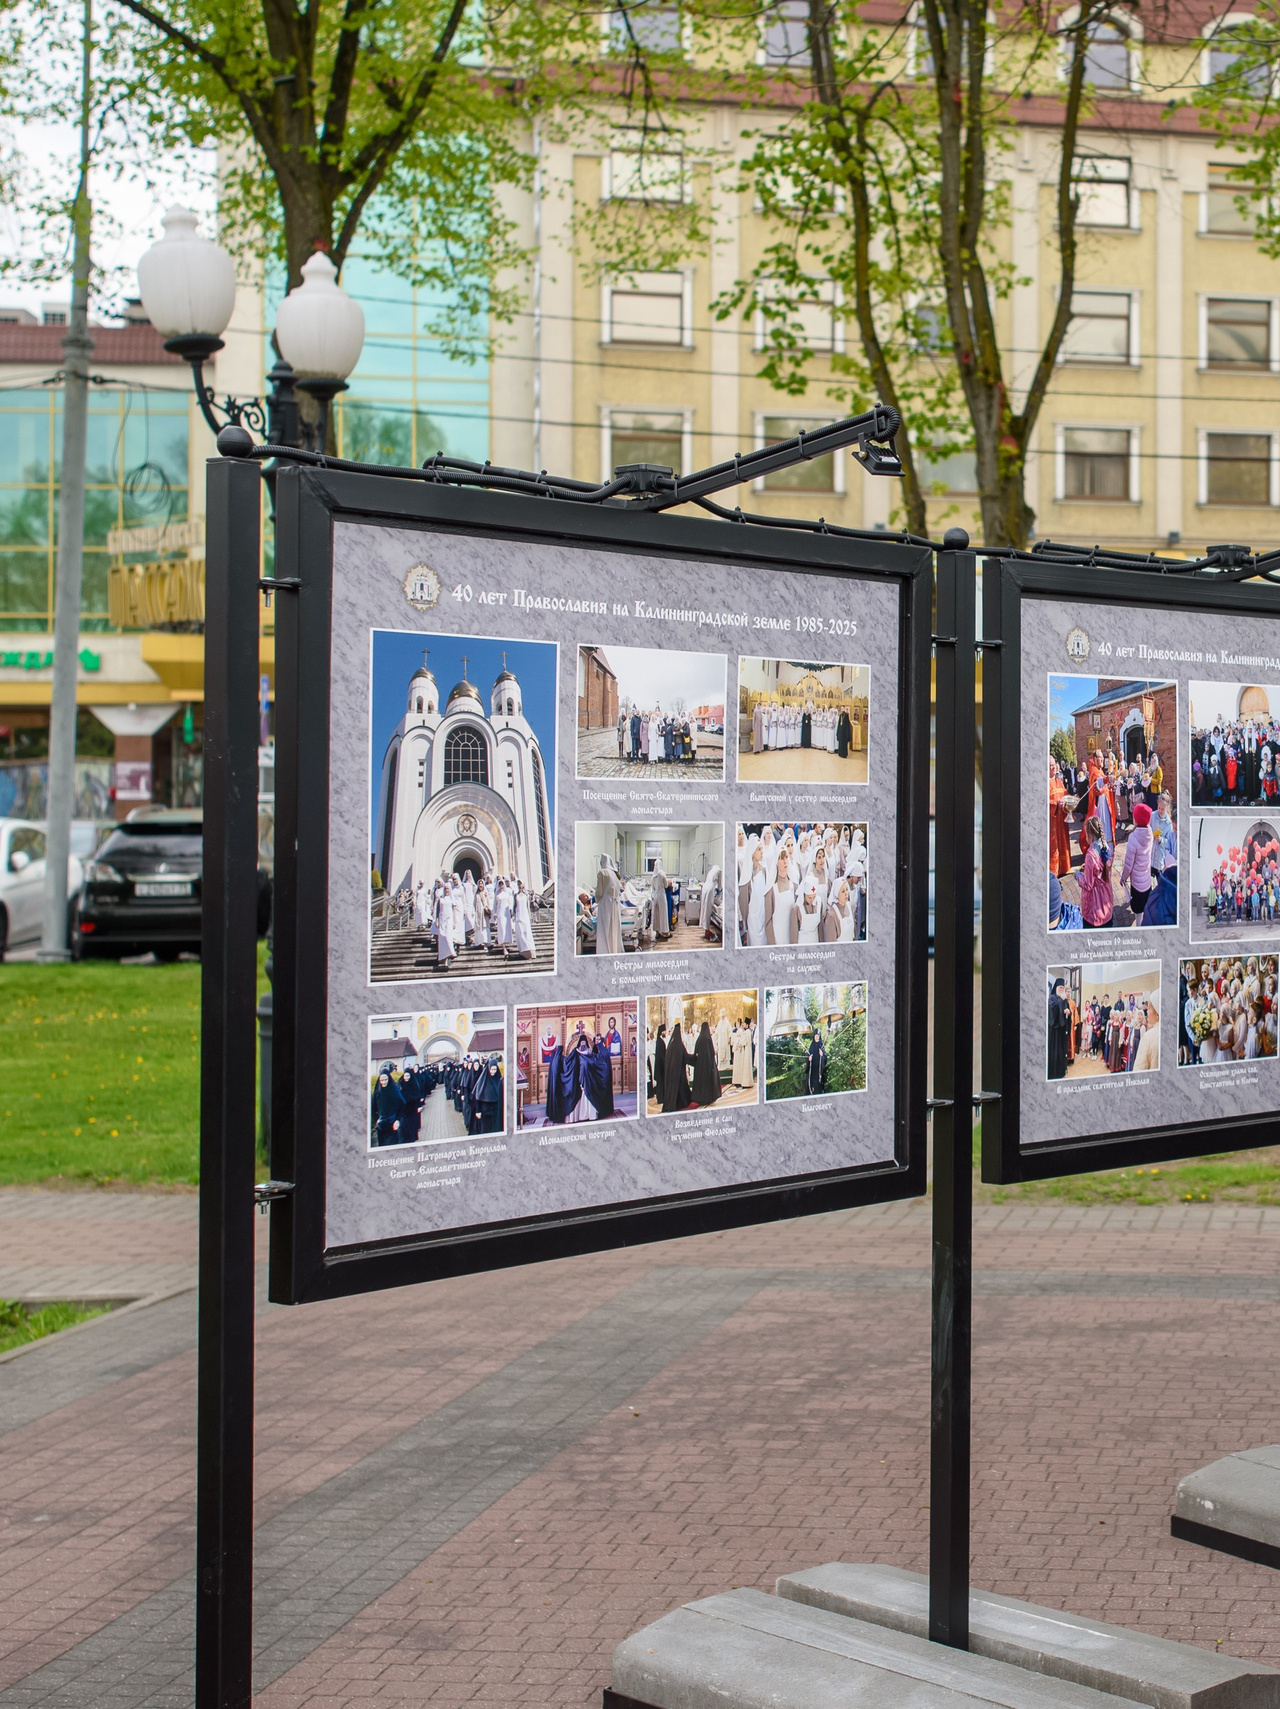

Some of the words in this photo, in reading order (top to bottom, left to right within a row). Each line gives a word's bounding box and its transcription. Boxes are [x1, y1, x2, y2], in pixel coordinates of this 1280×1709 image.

[451, 583, 473, 603] 40
[478, 591, 507, 606] лет
[513, 588, 607, 614] Православия
[612, 602, 629, 617] на
[634, 600, 748, 628] Калининградской
[752, 616, 791, 631] земле
[795, 615, 857, 637] 1985-2025
[1097, 641, 1112, 656] 40
[1115, 646, 1135, 658] лет
[1138, 644, 1202, 663] Православия
[1205, 653, 1218, 663] на
[582, 789, 627, 802] Посещение
[629, 790, 719, 803] Свято-Екатерининского
[631, 806, 673, 816] монастыря
[1114, 937, 1121, 946] 19
[769, 951, 796, 963] Сестры
[797, 951, 836, 961] милосердия
[613, 960, 643, 972] Сестры
[645, 959, 689, 970] милосердия
[797, 964, 822, 975] службе
[611, 977, 617, 985] в
[619, 973, 662, 984] больничной
[664, 972, 691, 981] палате
[801, 1102, 833, 1113] Благовест
[675, 1117, 714, 1130] Возведение
[721, 1115, 733, 1123] сан
[539, 1132, 587, 1146] Монашеский
[588, 1129, 617, 1140] постриг
[367, 1155, 415, 1169] Посещение
[417, 1148, 467, 1162] Патриархом
[469, 1144, 507, 1157] Кириллом
[416, 1176, 461, 1190] монастыря
